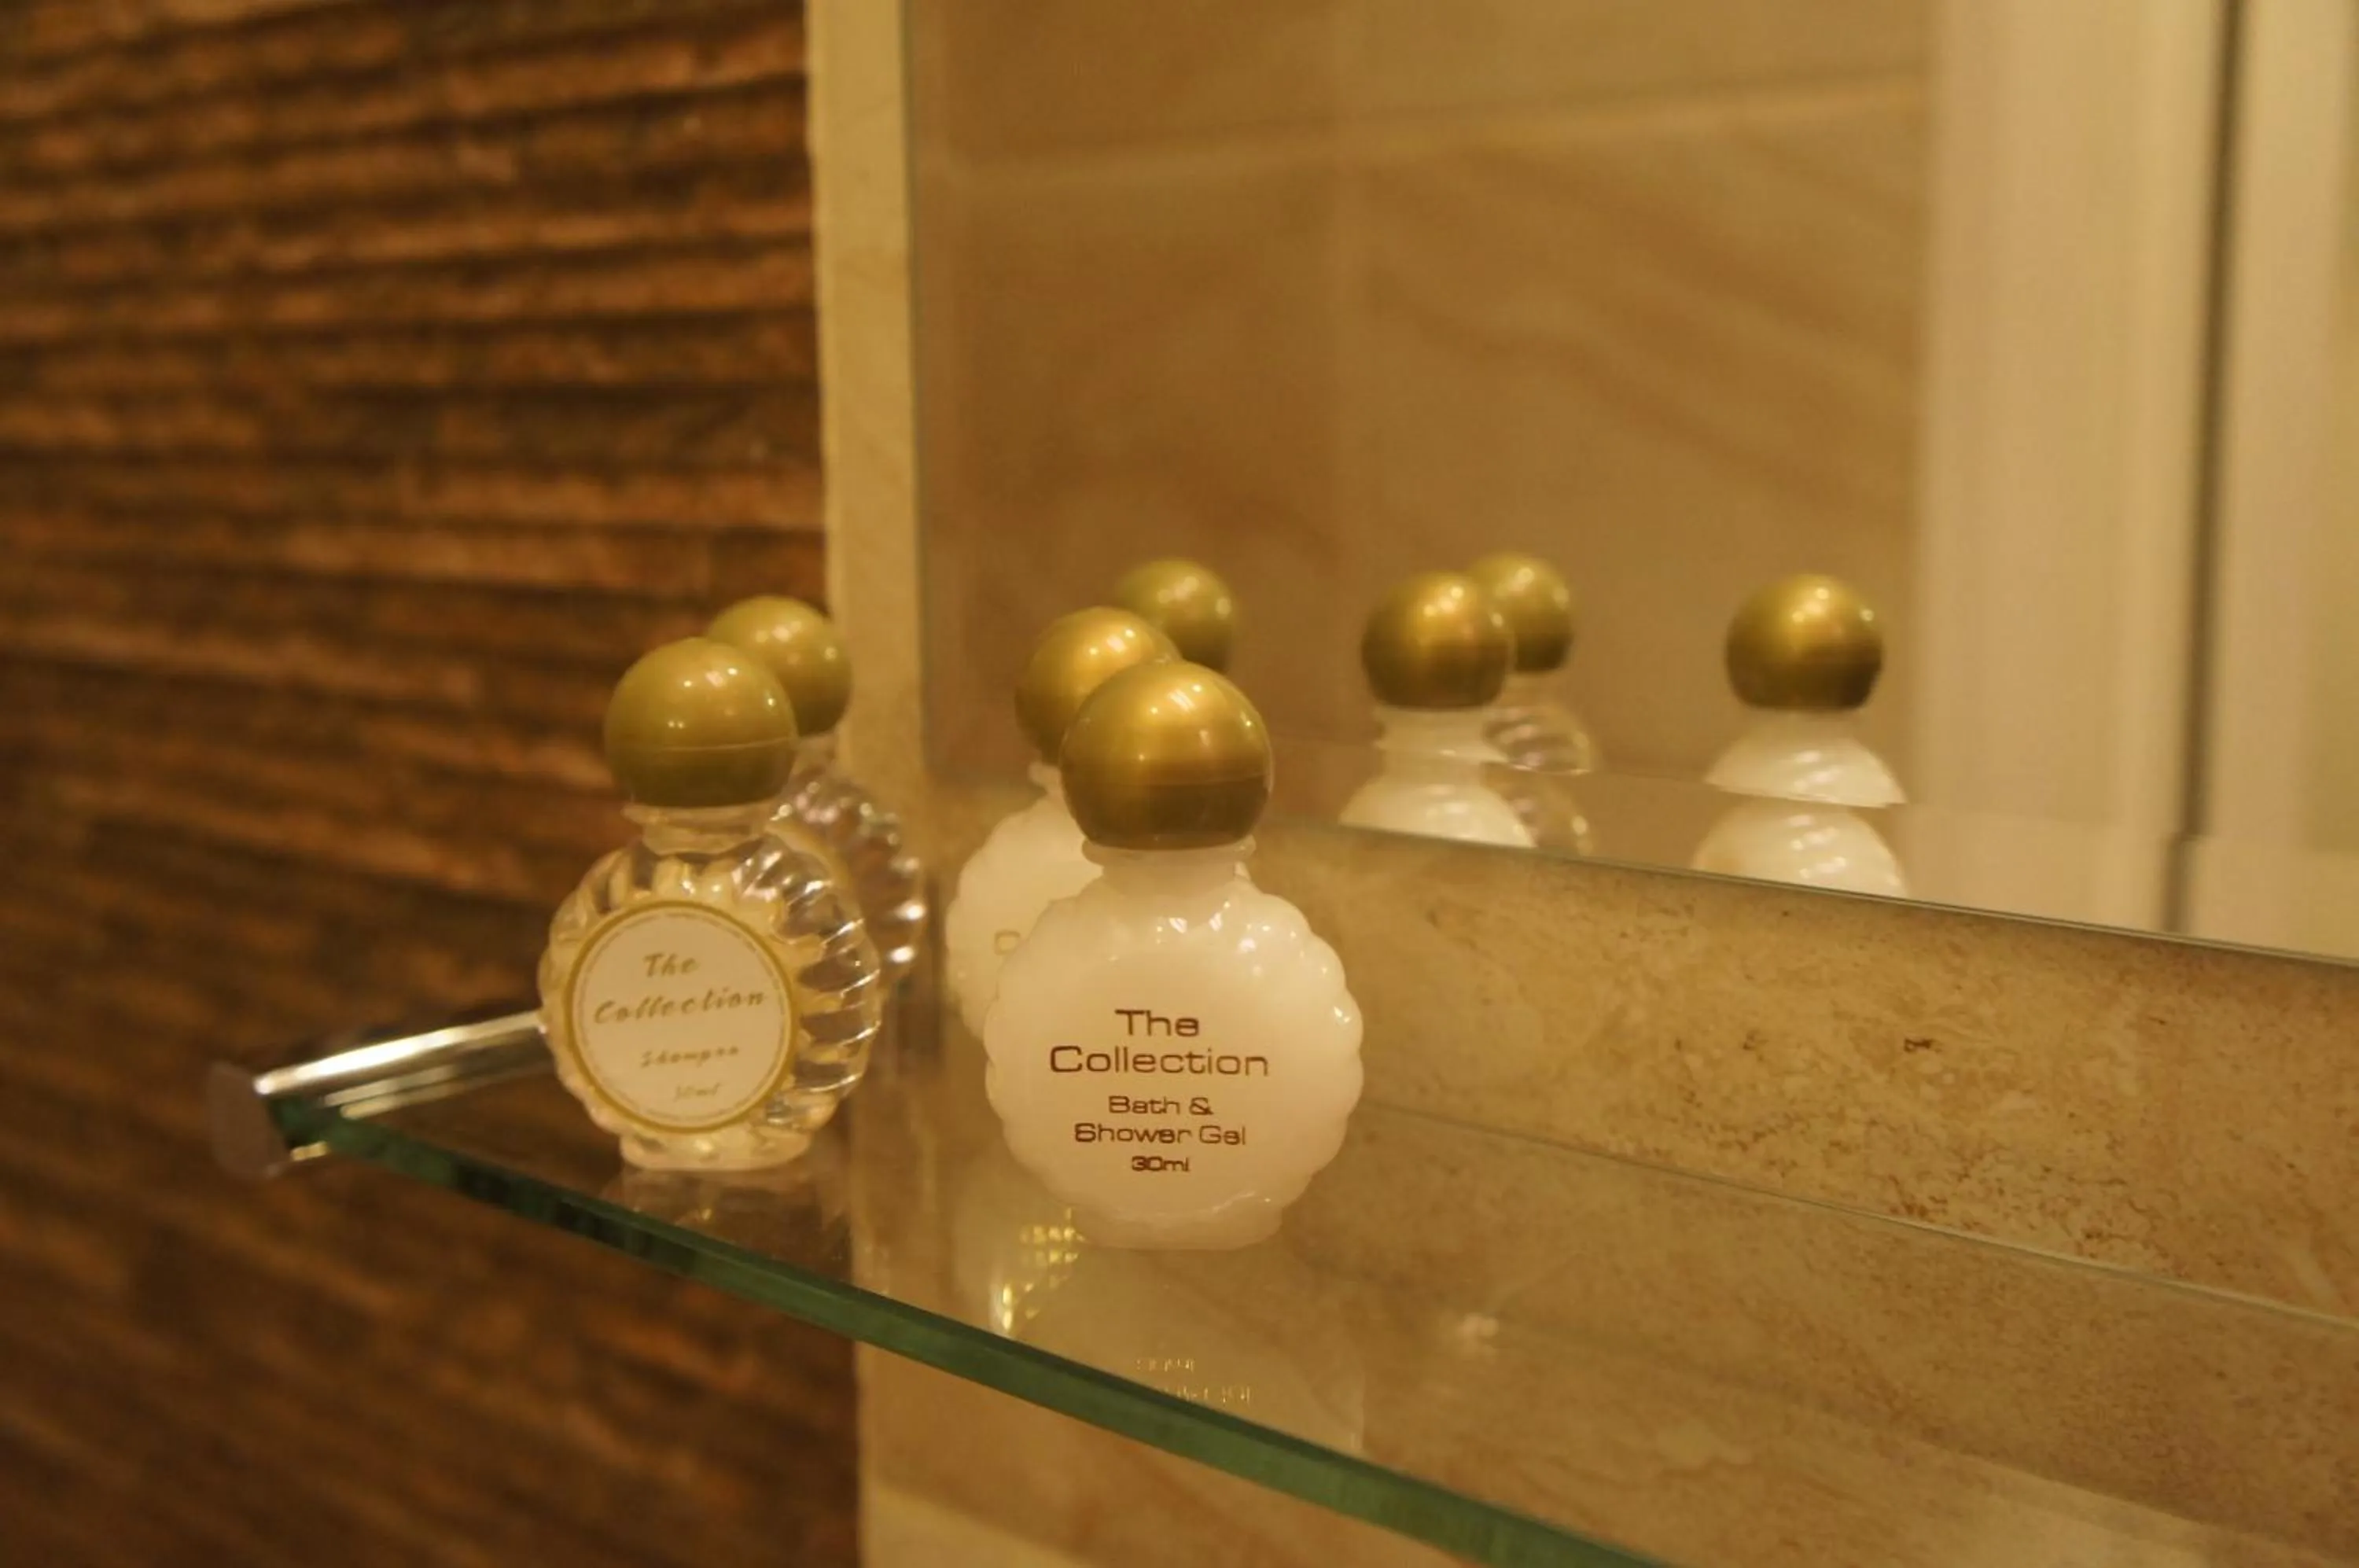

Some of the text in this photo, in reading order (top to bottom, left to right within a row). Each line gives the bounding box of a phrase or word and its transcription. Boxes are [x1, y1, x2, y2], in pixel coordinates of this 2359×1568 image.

[643, 952, 698, 977] The
[594, 988, 765, 1023] Collection
[1115, 1009, 1200, 1036] The
[1050, 1045, 1268, 1076] Collection
[1109, 1095, 1213, 1115] Bath &
[1075, 1123, 1246, 1145] Shower Gel
[1132, 1155, 1190, 1172] 30ml
